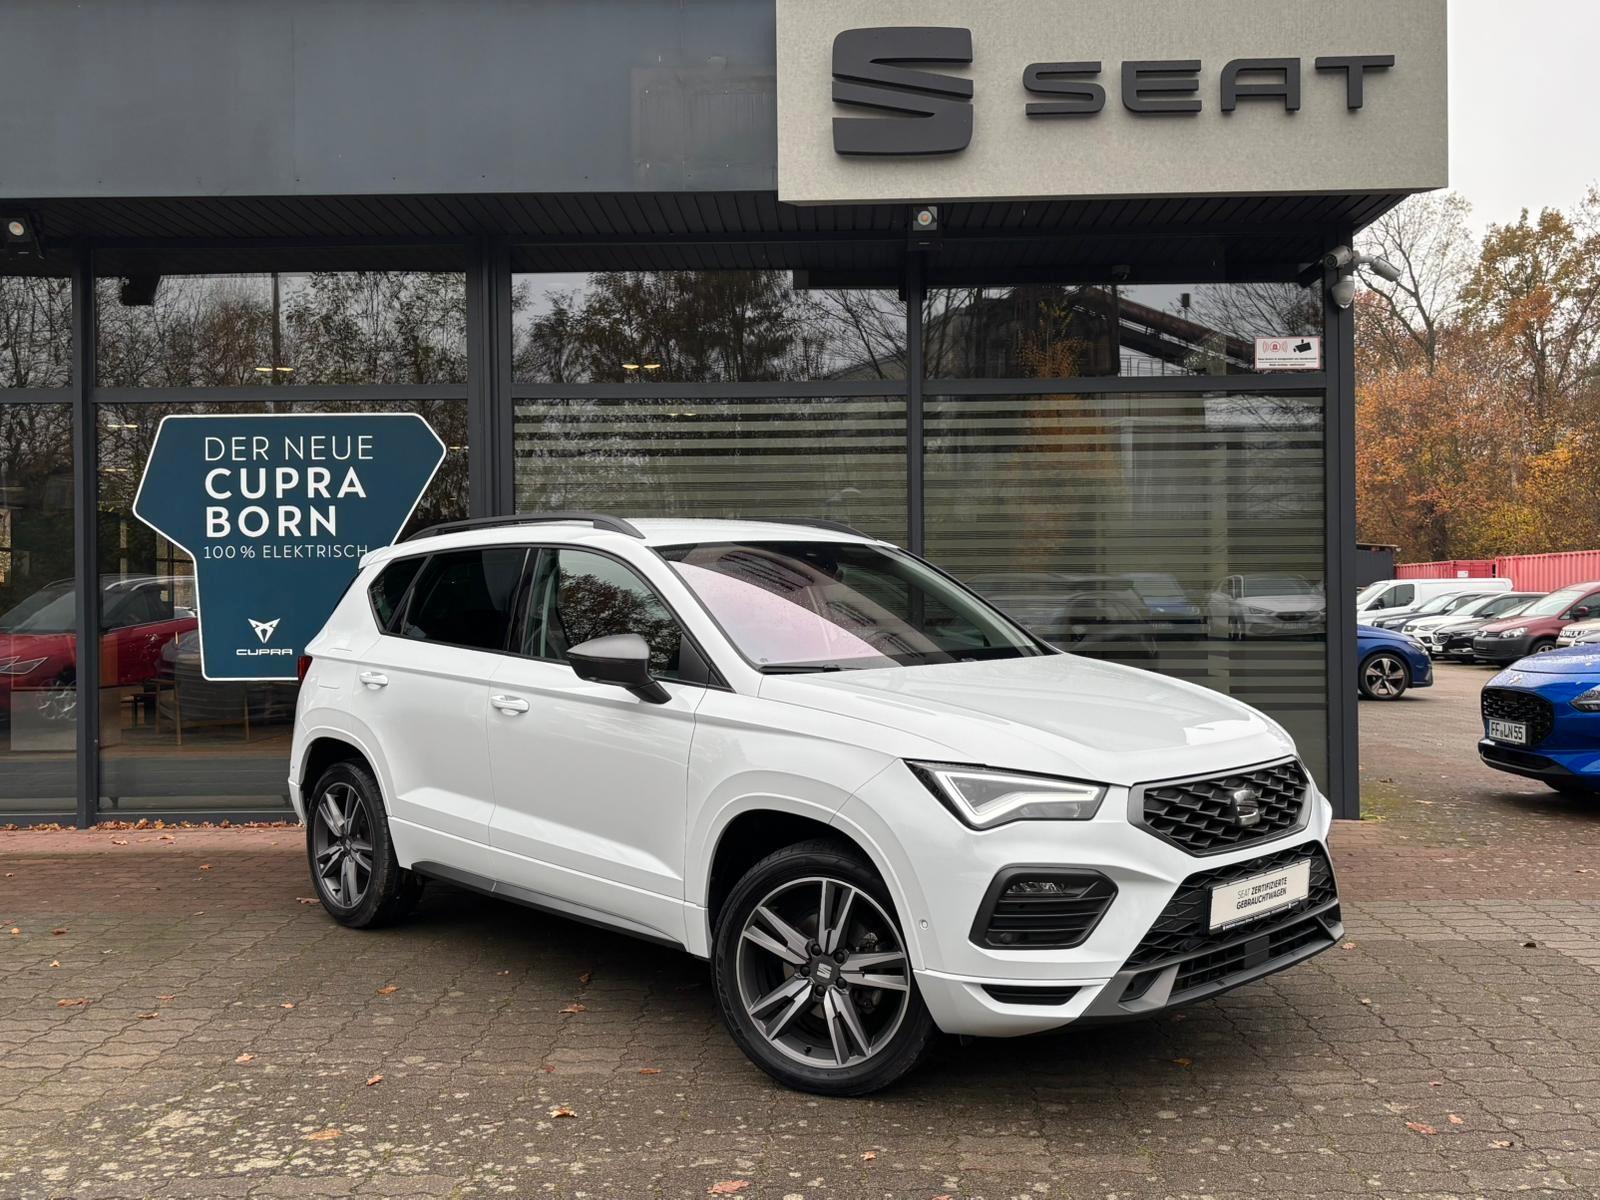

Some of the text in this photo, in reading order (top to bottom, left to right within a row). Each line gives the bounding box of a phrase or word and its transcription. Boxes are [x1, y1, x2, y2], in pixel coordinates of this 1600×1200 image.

[1022, 54, 1396, 116] SEAT
[204, 434, 374, 462] DER NEUE
[204, 466, 367, 499] CUPRA
[205, 505, 337, 538] BORN
[203, 543, 368, 559] 100 % ELEKTRISCH
[235, 648, 293, 656] CUPRA
[1236, 888, 1287, 909] GEBRAUCHTWAGEN
[1237, 877, 1287, 899] SEAT ZERTIFIZIERTE
